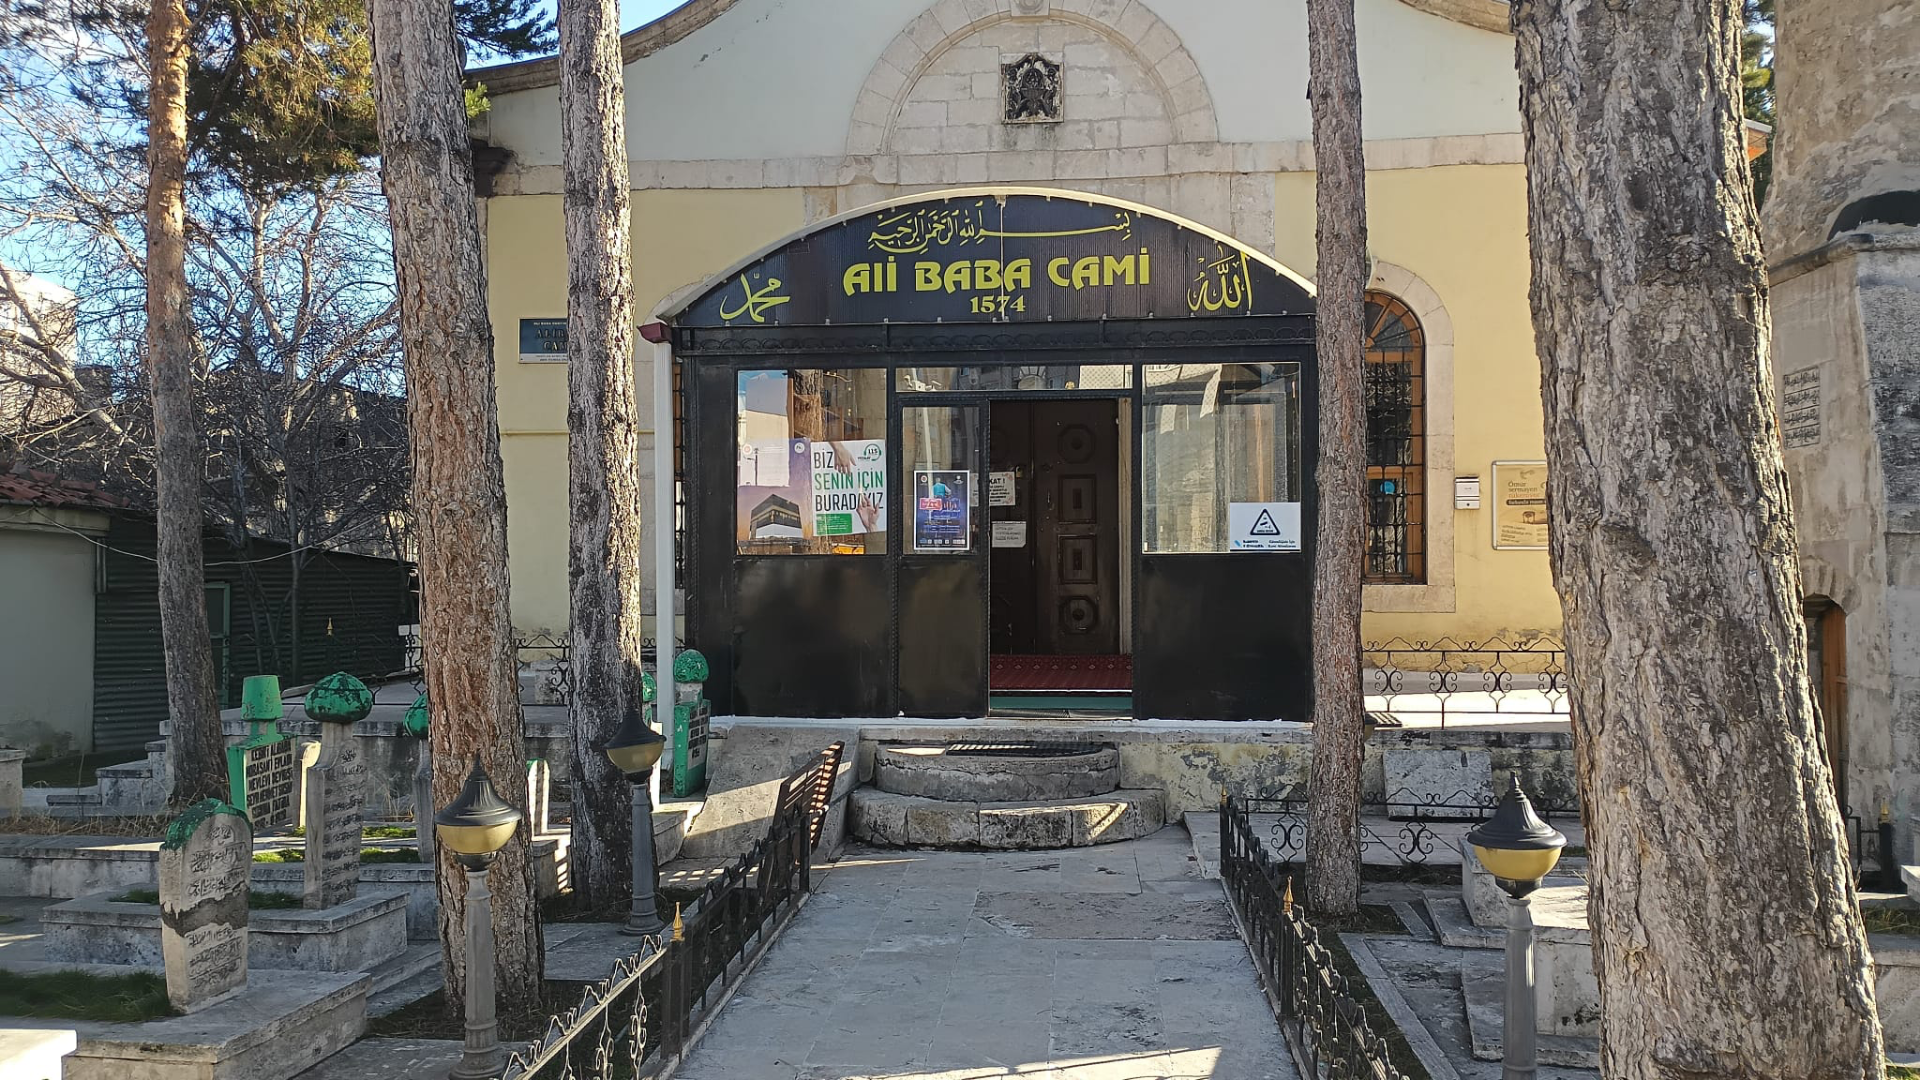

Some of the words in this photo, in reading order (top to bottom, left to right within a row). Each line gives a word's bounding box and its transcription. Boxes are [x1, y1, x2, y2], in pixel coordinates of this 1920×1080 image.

[915, 259, 1031, 294] BABA
[1047, 247, 1150, 291] CAMİ
[970, 295, 1026, 313] 1574
[814, 448, 834, 469] BİZ
[857, 467, 884, 491] İÇİN
